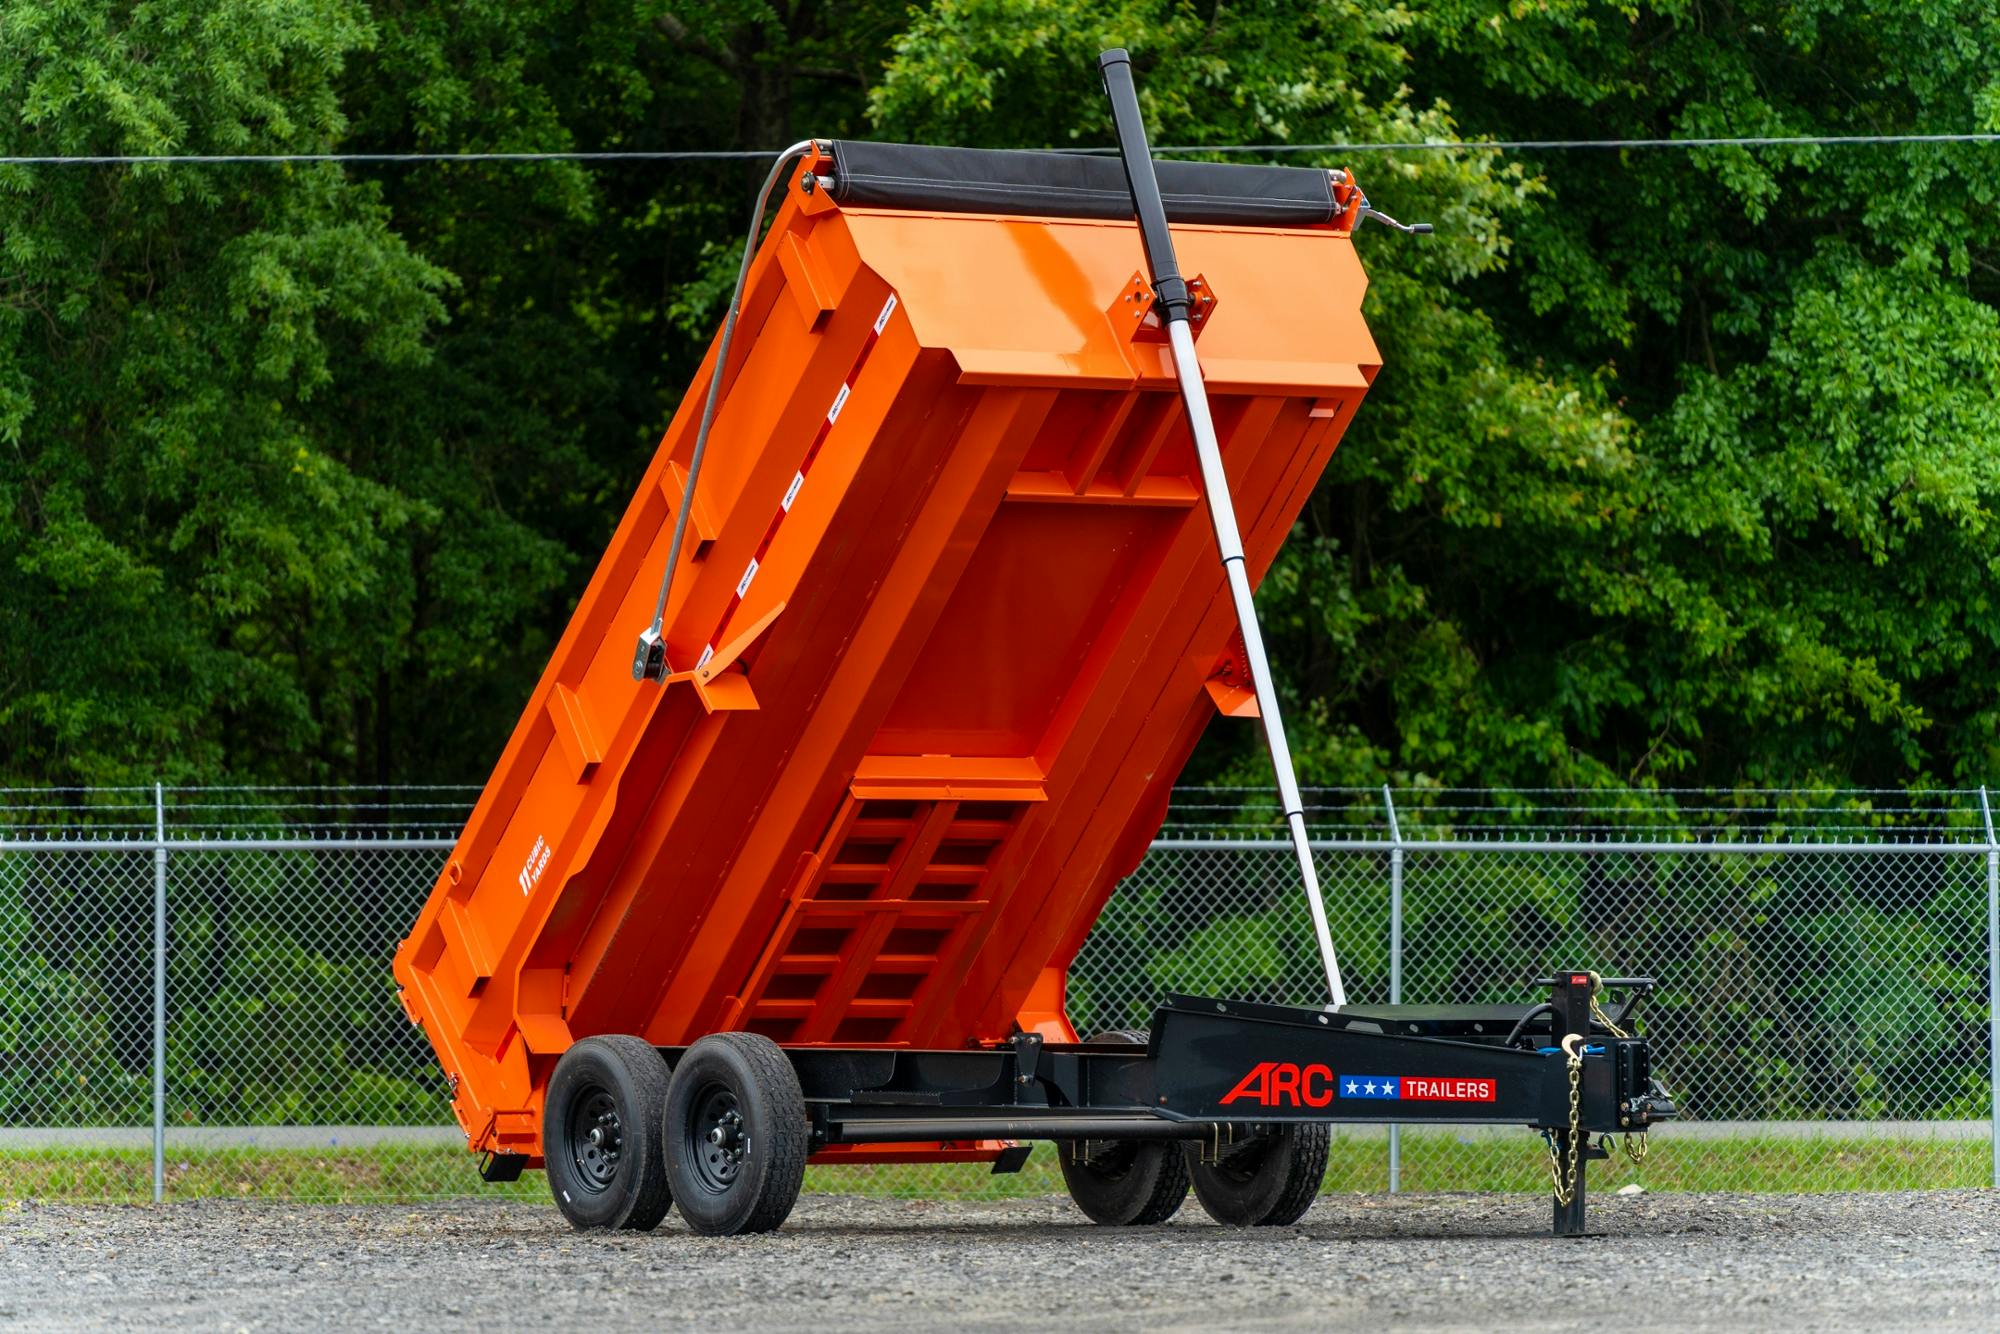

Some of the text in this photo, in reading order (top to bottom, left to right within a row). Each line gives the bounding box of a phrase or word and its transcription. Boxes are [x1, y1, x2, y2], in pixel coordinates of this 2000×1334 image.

[519, 834, 544, 897] 11 CUBIC
[531, 846, 551, 884] YARDS
[1218, 1062, 1489, 1108] ARC TRAILERS
